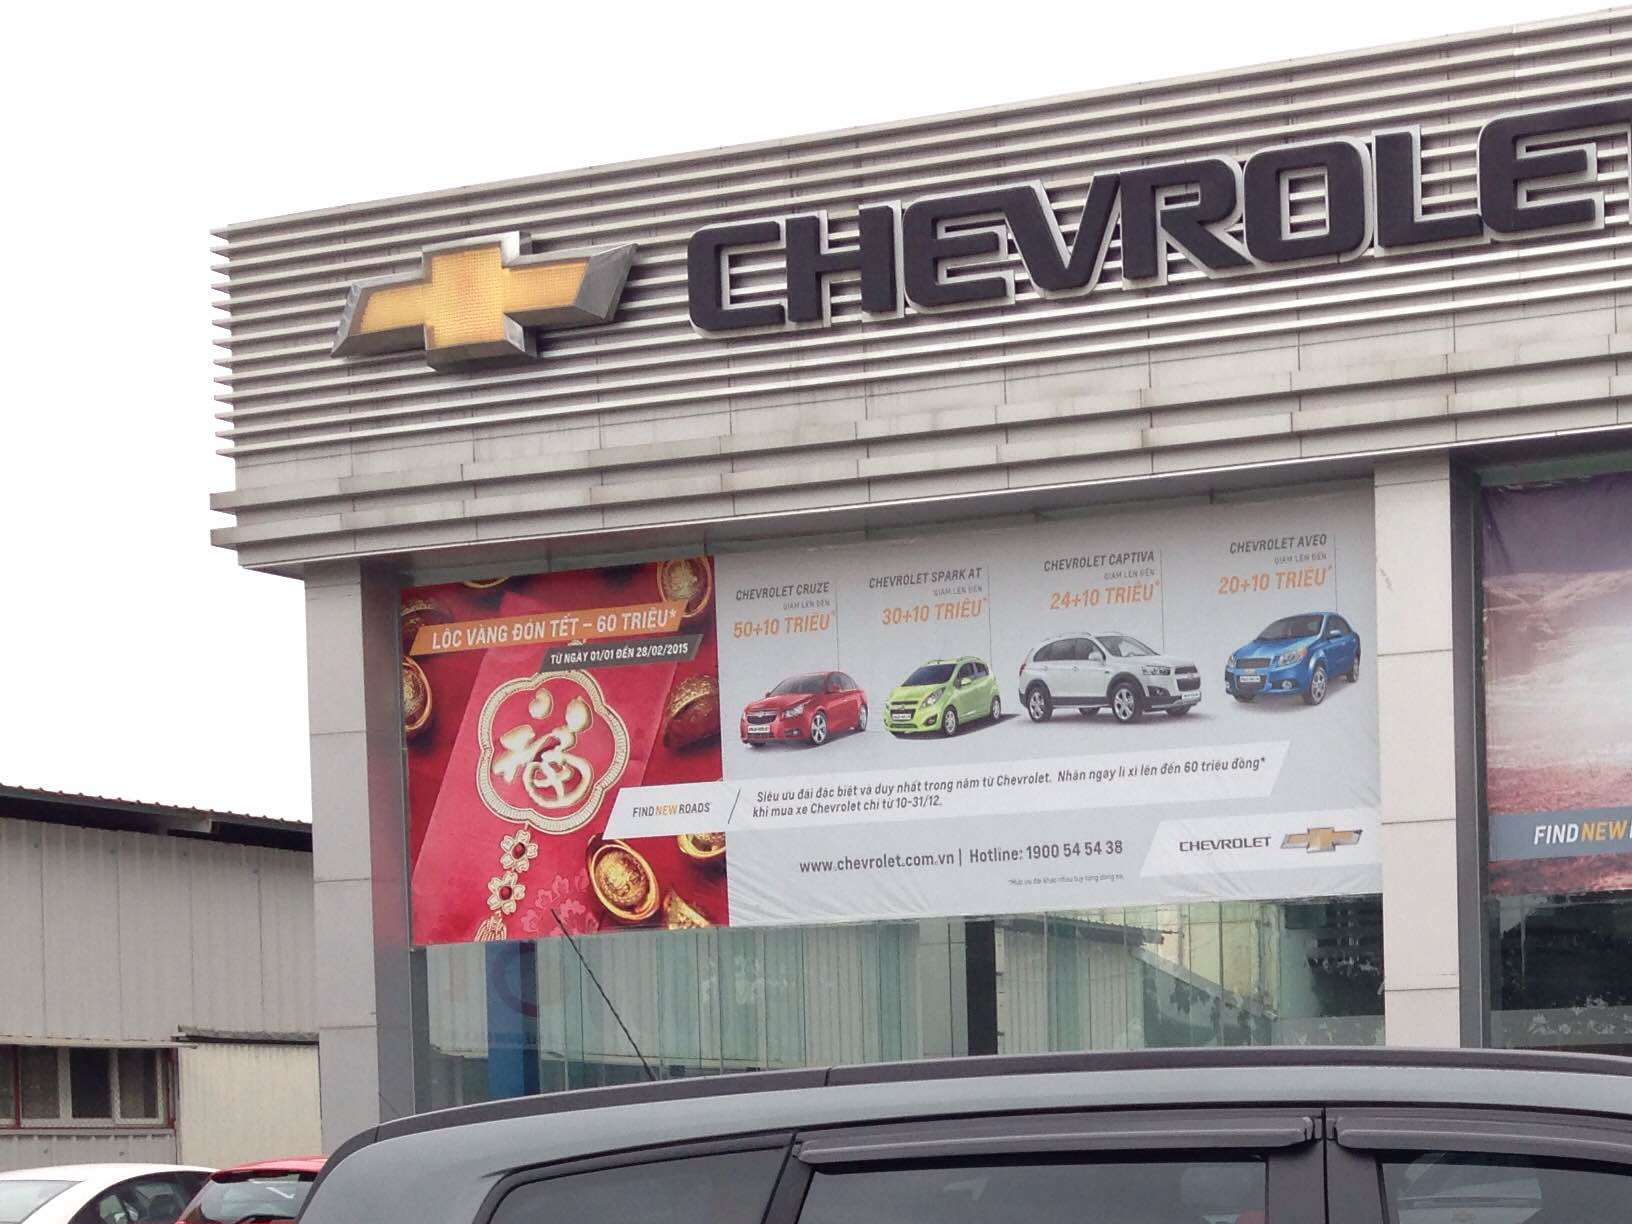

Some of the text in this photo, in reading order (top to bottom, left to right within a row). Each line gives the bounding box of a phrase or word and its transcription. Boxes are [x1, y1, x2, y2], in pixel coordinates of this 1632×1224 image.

[1230, 533, 1327, 554] CHEVROLET AVEO
[1044, 550, 1154, 572] CHEVROLET CAPTIVA
[869, 567, 982, 588] CHEVROLET SPARK AT
[1218, 572, 1270, 594] 20+10
[736, 581, 830, 601] CHEVROLET CRUZE
[1050, 588, 1099, 610] 24+10
[597, 614, 617, 633] 60
[882, 603, 929, 625] 30+10
[734, 617, 780, 638] 50+10
[590, 650, 614, 662] 01/01
[636, 642, 689, 658] 28/02/2015
[875, 783, 895, 797] duy
[924, 779, 954, 793] trong
[1089, 768, 1116, 782] ngay
[1184, 761, 1198, 773] 60
[632, 802, 710, 818] FIND NEW ROADS
[752, 806, 769, 818] khi
[771, 807, 793, 817] mua
[795, 806, 808, 816] xe
[810, 801, 861, 814] Chevrolet
[1534, 823, 1578, 845] FIND
[1581, 820, 1628, 842] NEW
[1179, 836, 1271, 852] CHEVROLET
[800, 839, 1123, 873] www.chevrolet.com.vn Hotline: 1900 54 54 38
